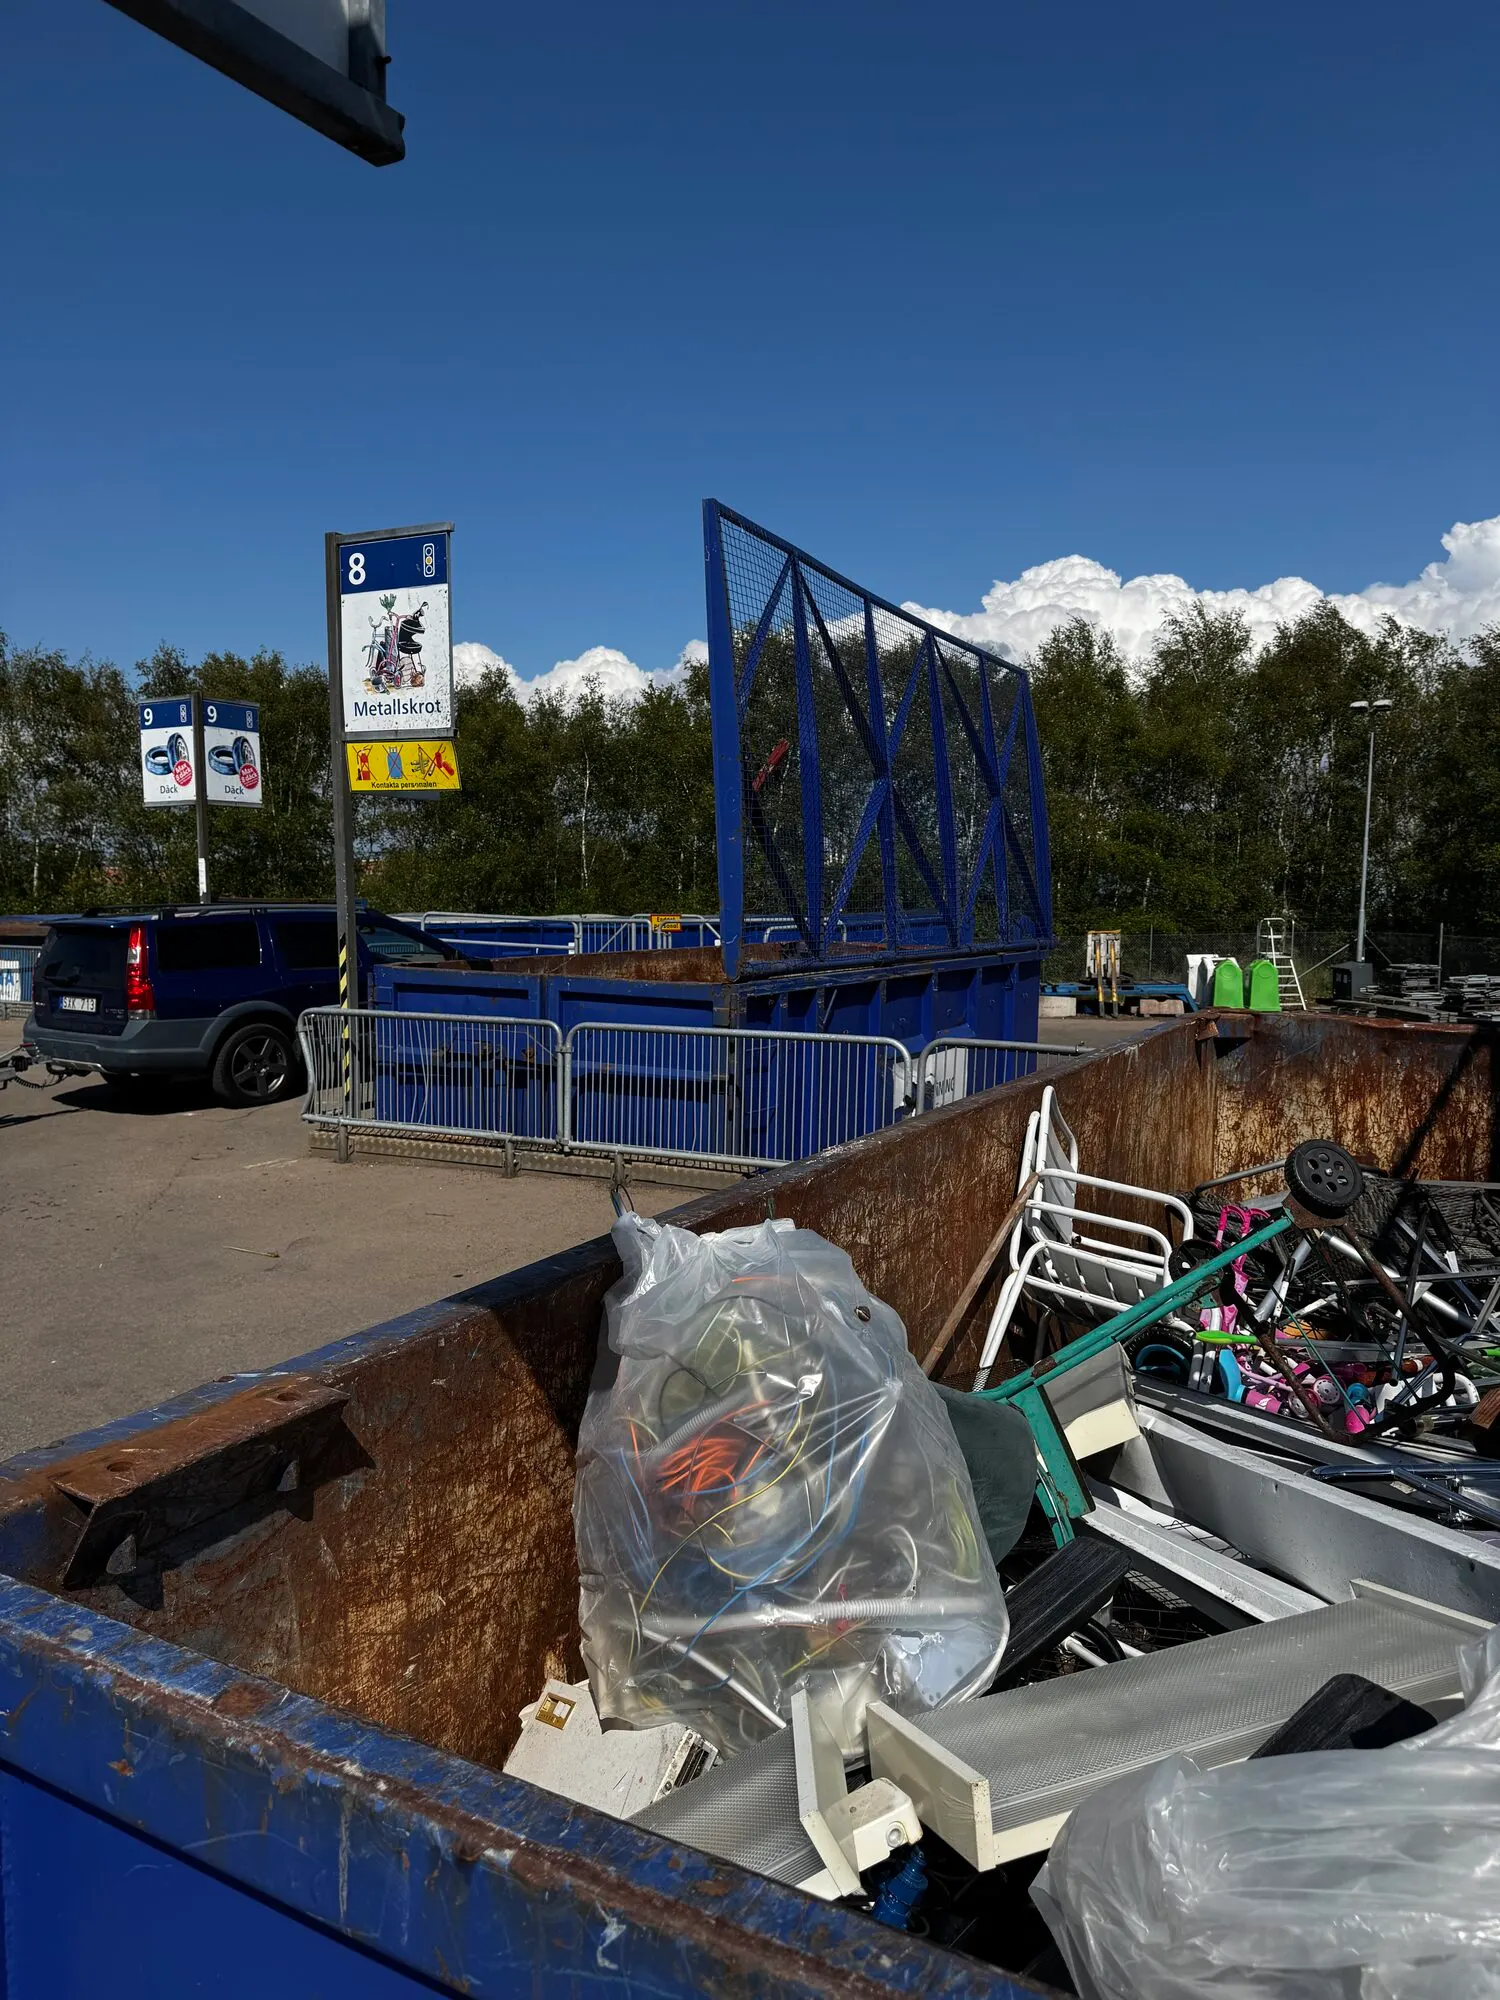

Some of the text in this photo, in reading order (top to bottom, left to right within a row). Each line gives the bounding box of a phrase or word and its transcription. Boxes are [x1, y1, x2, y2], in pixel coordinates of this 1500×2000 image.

[348, 552, 366, 585] 8
[143, 707, 153, 726] 9
[207, 705, 217, 723] 9
[354, 698, 442, 717] Metallskrot
[160, 784, 178, 795] Däck
[224, 785, 244, 795] Däck
[371, 781, 437, 790] Kontakta personalen
